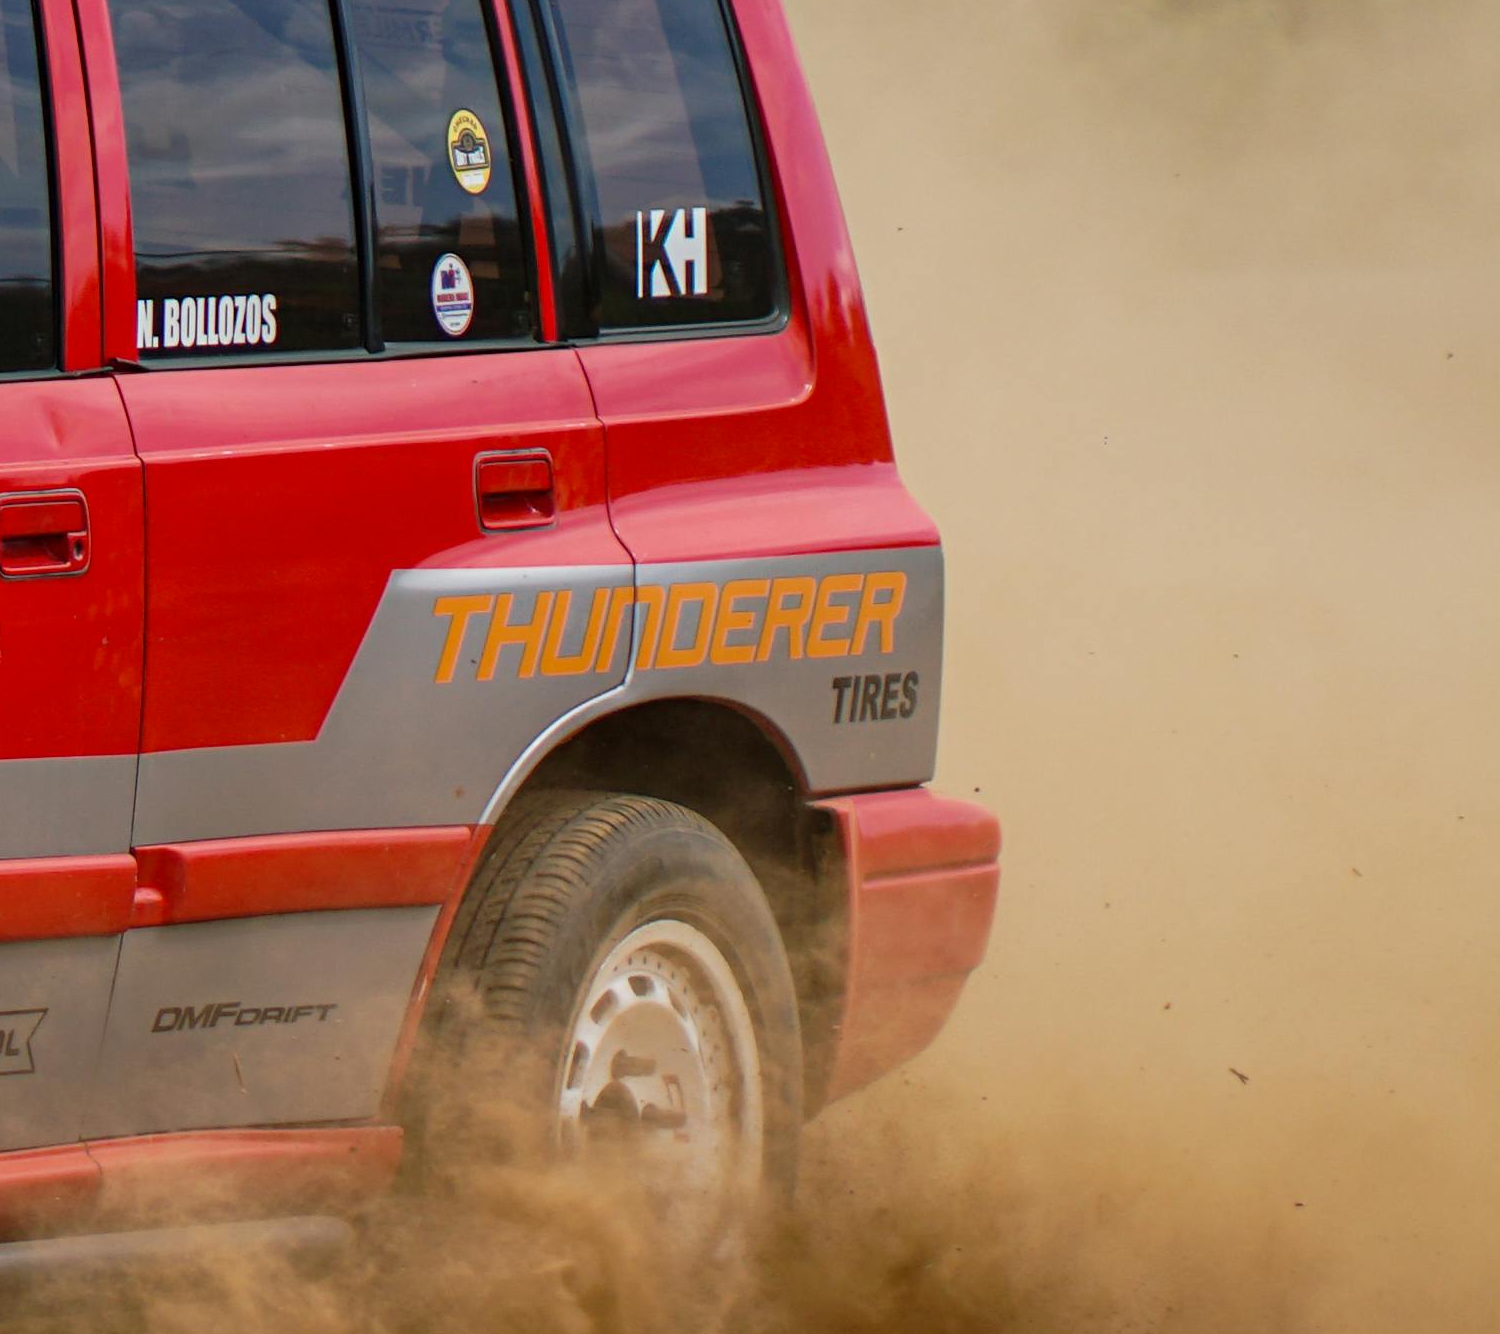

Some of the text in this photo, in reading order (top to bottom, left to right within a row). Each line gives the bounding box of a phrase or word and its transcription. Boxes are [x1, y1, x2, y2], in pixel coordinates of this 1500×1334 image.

[137, 293, 277, 348] N. BOLLOZOS
[432, 571, 906, 683] THUNDERER
[831, 671, 919, 724] TIRES
